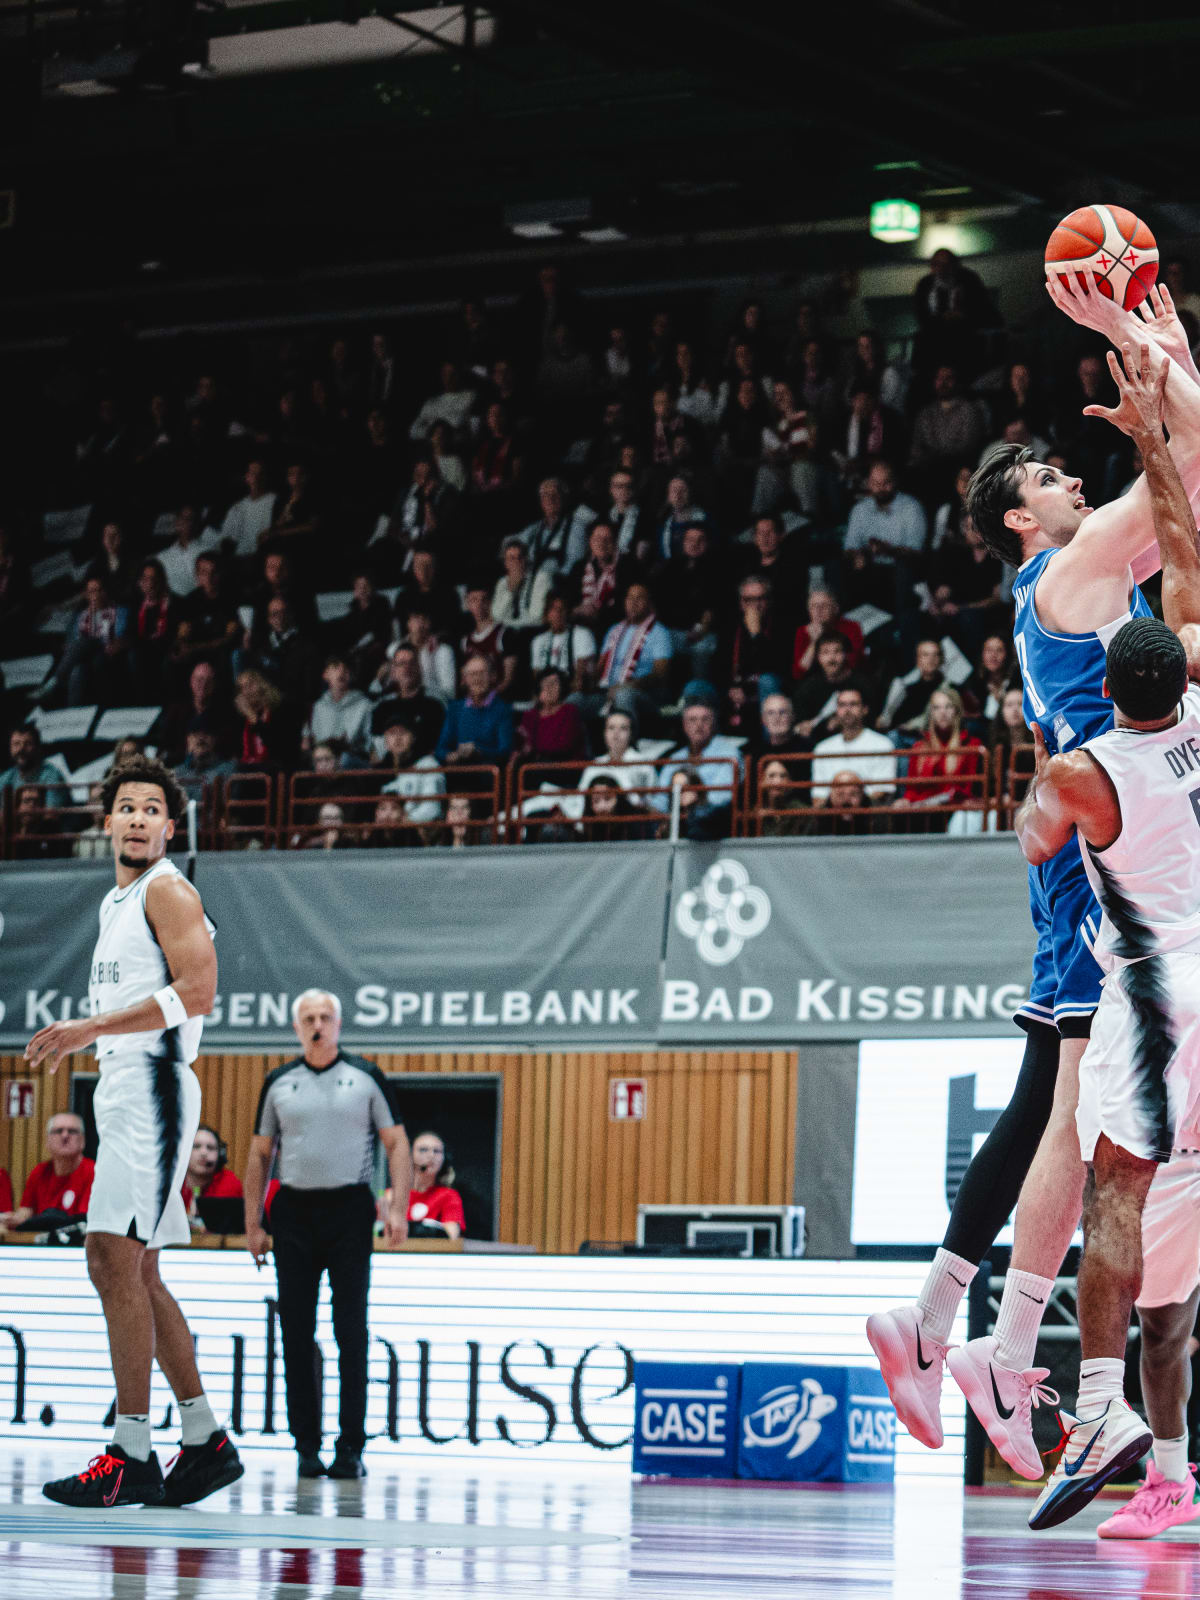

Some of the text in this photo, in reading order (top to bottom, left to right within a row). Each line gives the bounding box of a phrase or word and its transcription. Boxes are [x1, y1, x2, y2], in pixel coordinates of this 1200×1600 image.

[354, 979, 1027, 1025] SPIELBANK BAD KISSING
[641, 1402, 727, 1442] CASE
[849, 1410, 895, 1449] CASE
